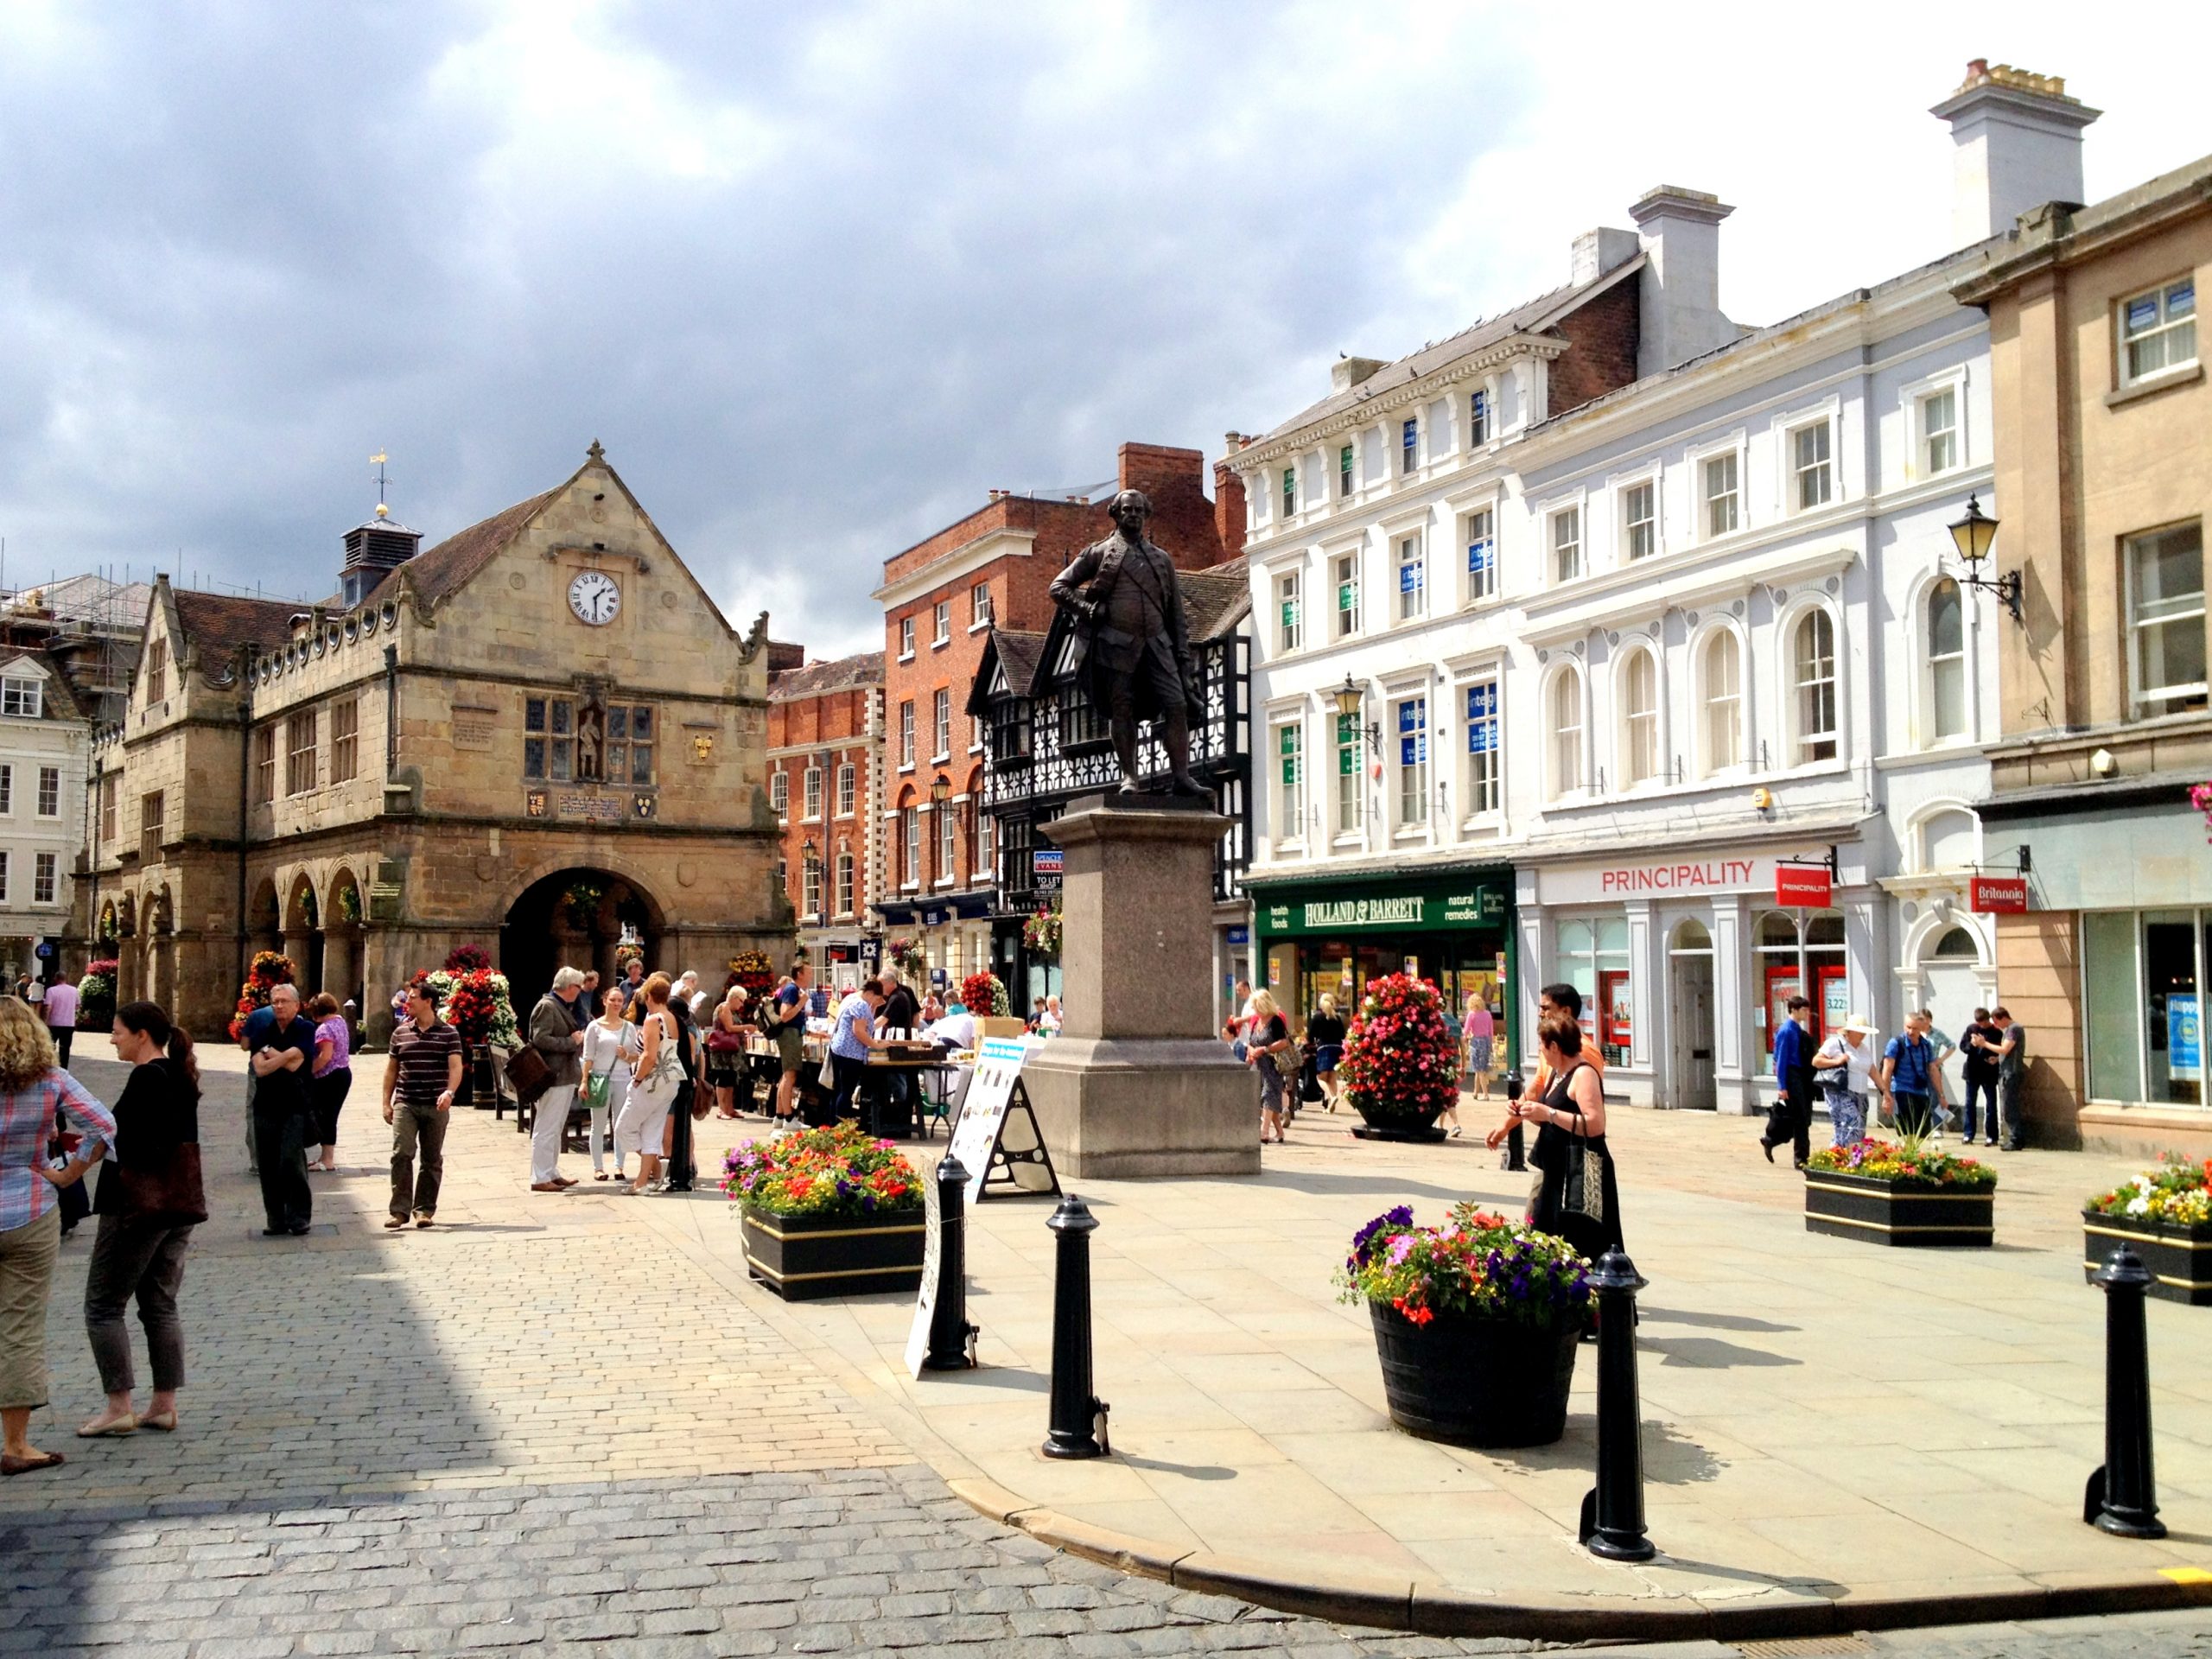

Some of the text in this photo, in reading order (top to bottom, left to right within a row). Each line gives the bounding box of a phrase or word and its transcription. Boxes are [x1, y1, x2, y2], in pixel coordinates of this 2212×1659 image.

[1602, 861, 1754, 892] PRINCIPALITY
[1782, 883, 1827, 893] PRINCIPALITY
[1979, 886, 2024, 899] Britannia
[1448, 893, 1474, 906] natural
[1270, 906, 1288, 916] health
[1305, 897, 1424, 927] HOLLAND & BARRETT
[1445, 908, 1478, 921] remedies
[1271, 918, 1287, 929] foods
